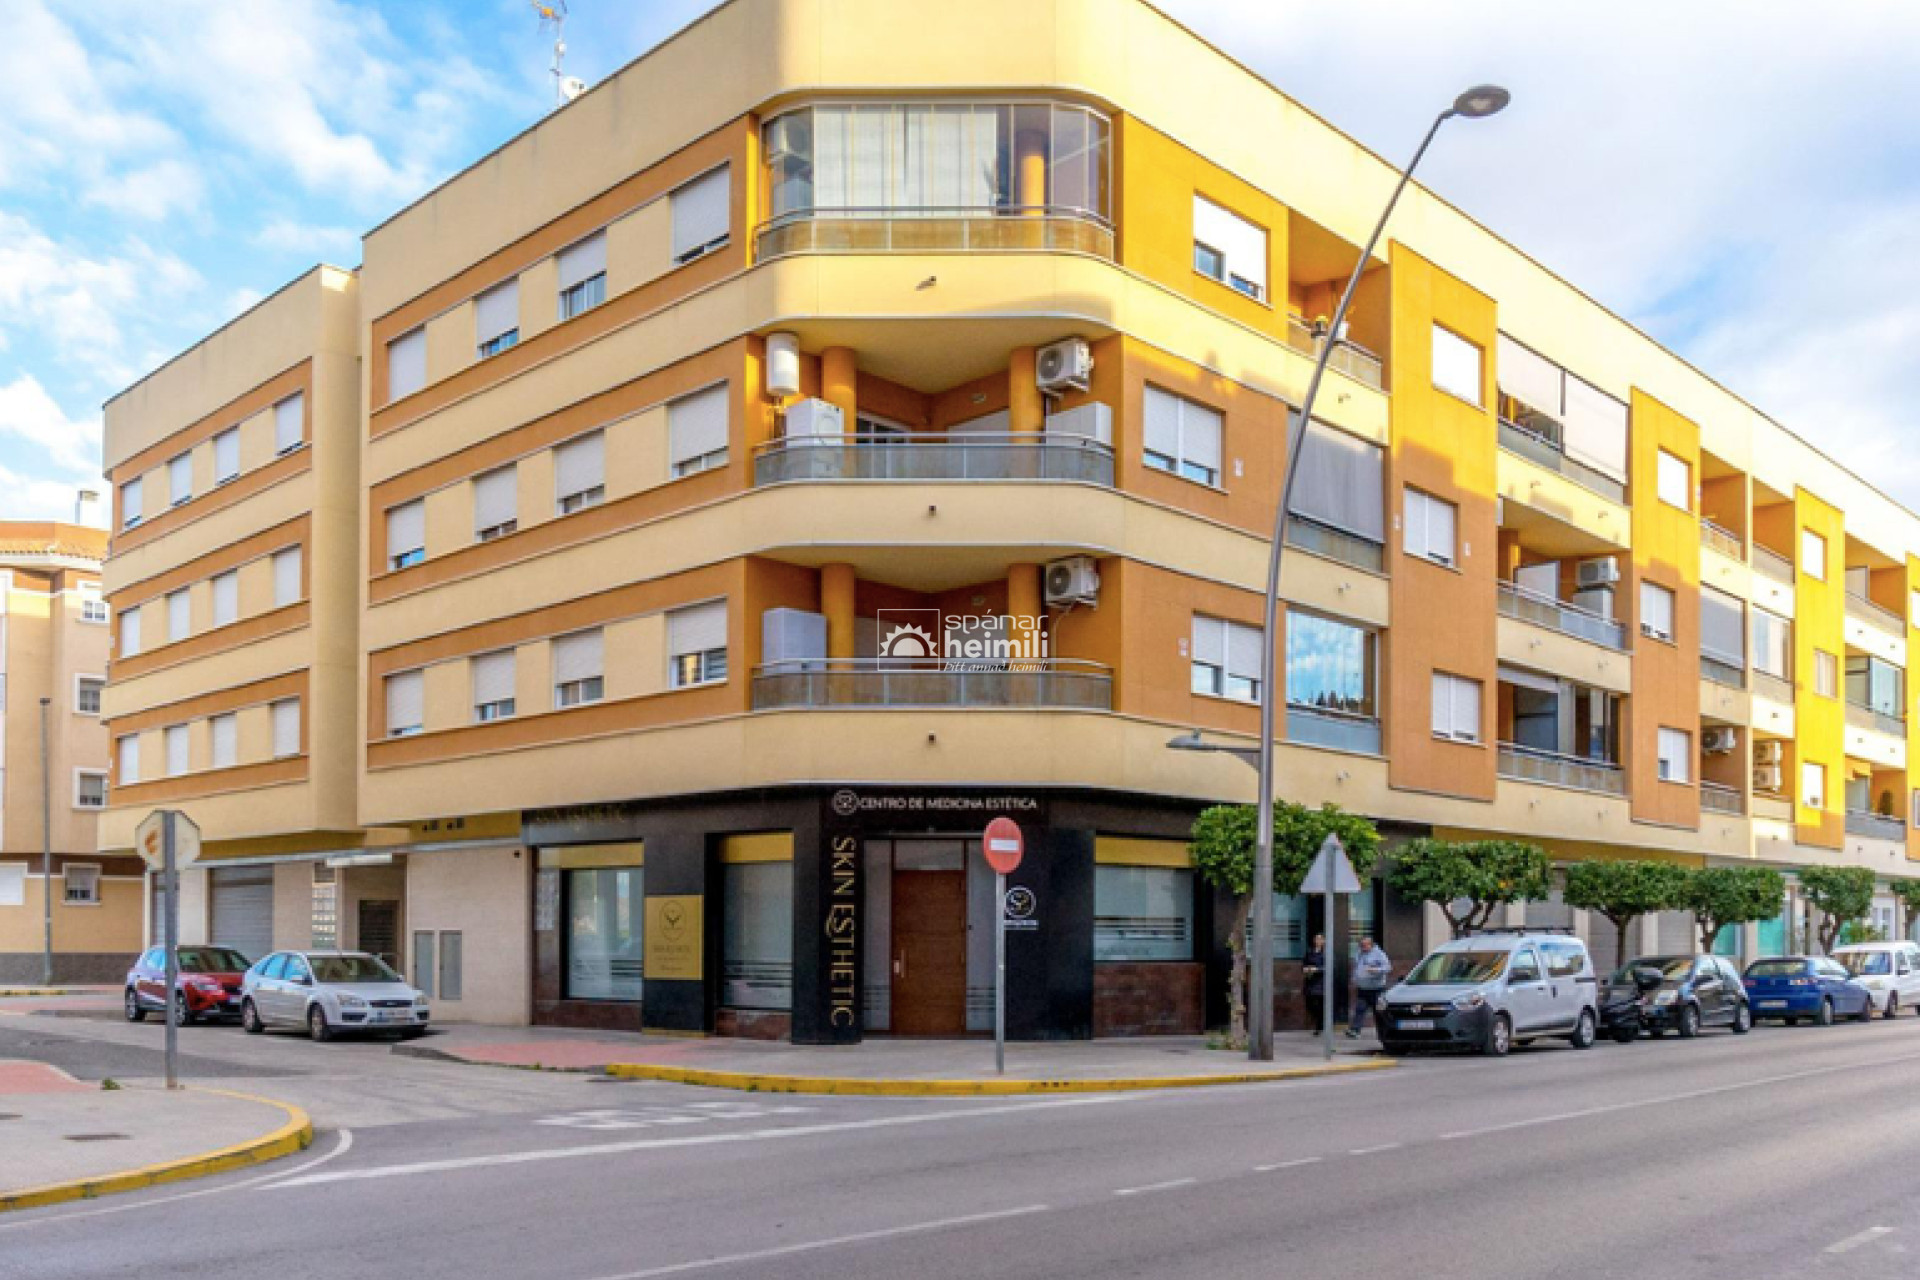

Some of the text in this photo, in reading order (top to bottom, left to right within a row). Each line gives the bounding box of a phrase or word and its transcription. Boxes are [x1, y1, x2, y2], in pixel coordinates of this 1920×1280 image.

[859, 797, 907, 810] CENTRO
[908, 797, 925, 810] DE
[925, 797, 985, 810] MEDICINA
[825, 836, 856, 1027] SKIN ESTHETIC
